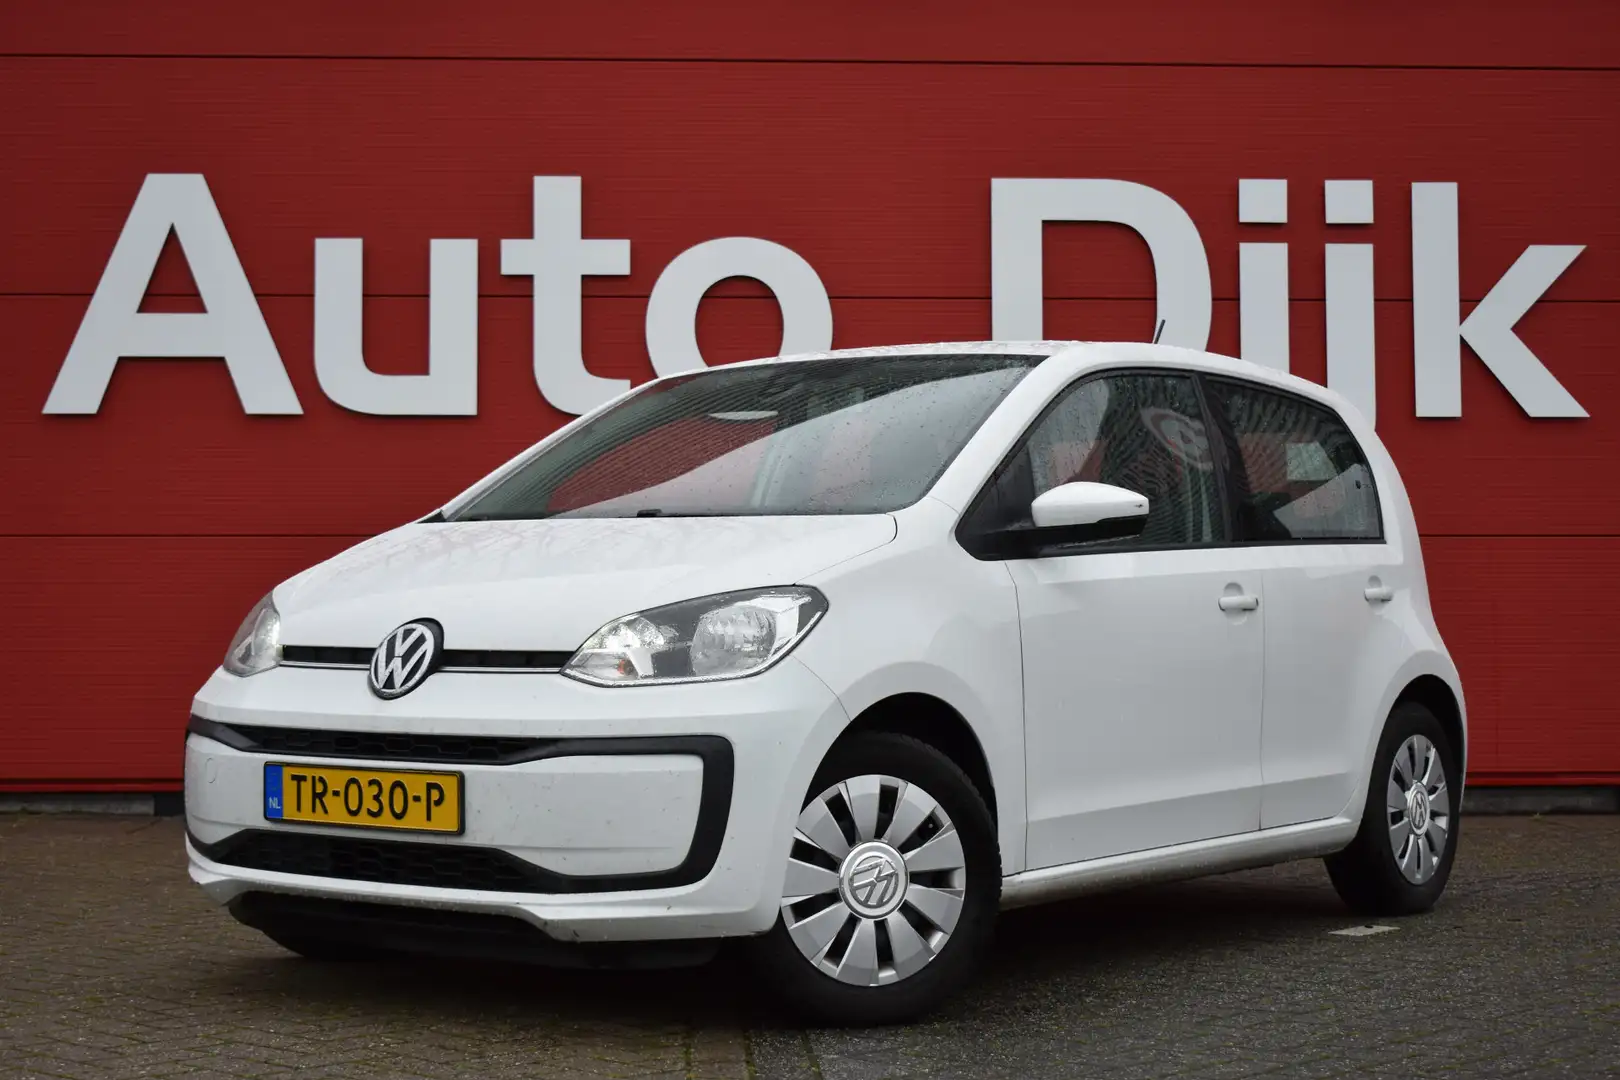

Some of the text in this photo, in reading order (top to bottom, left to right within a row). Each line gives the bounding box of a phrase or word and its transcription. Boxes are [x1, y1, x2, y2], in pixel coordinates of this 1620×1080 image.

[43, 173, 1590, 431] Auto Dijk
[269, 797, 281, 809] NL
[291, 774, 445, 822] TR-030-P
